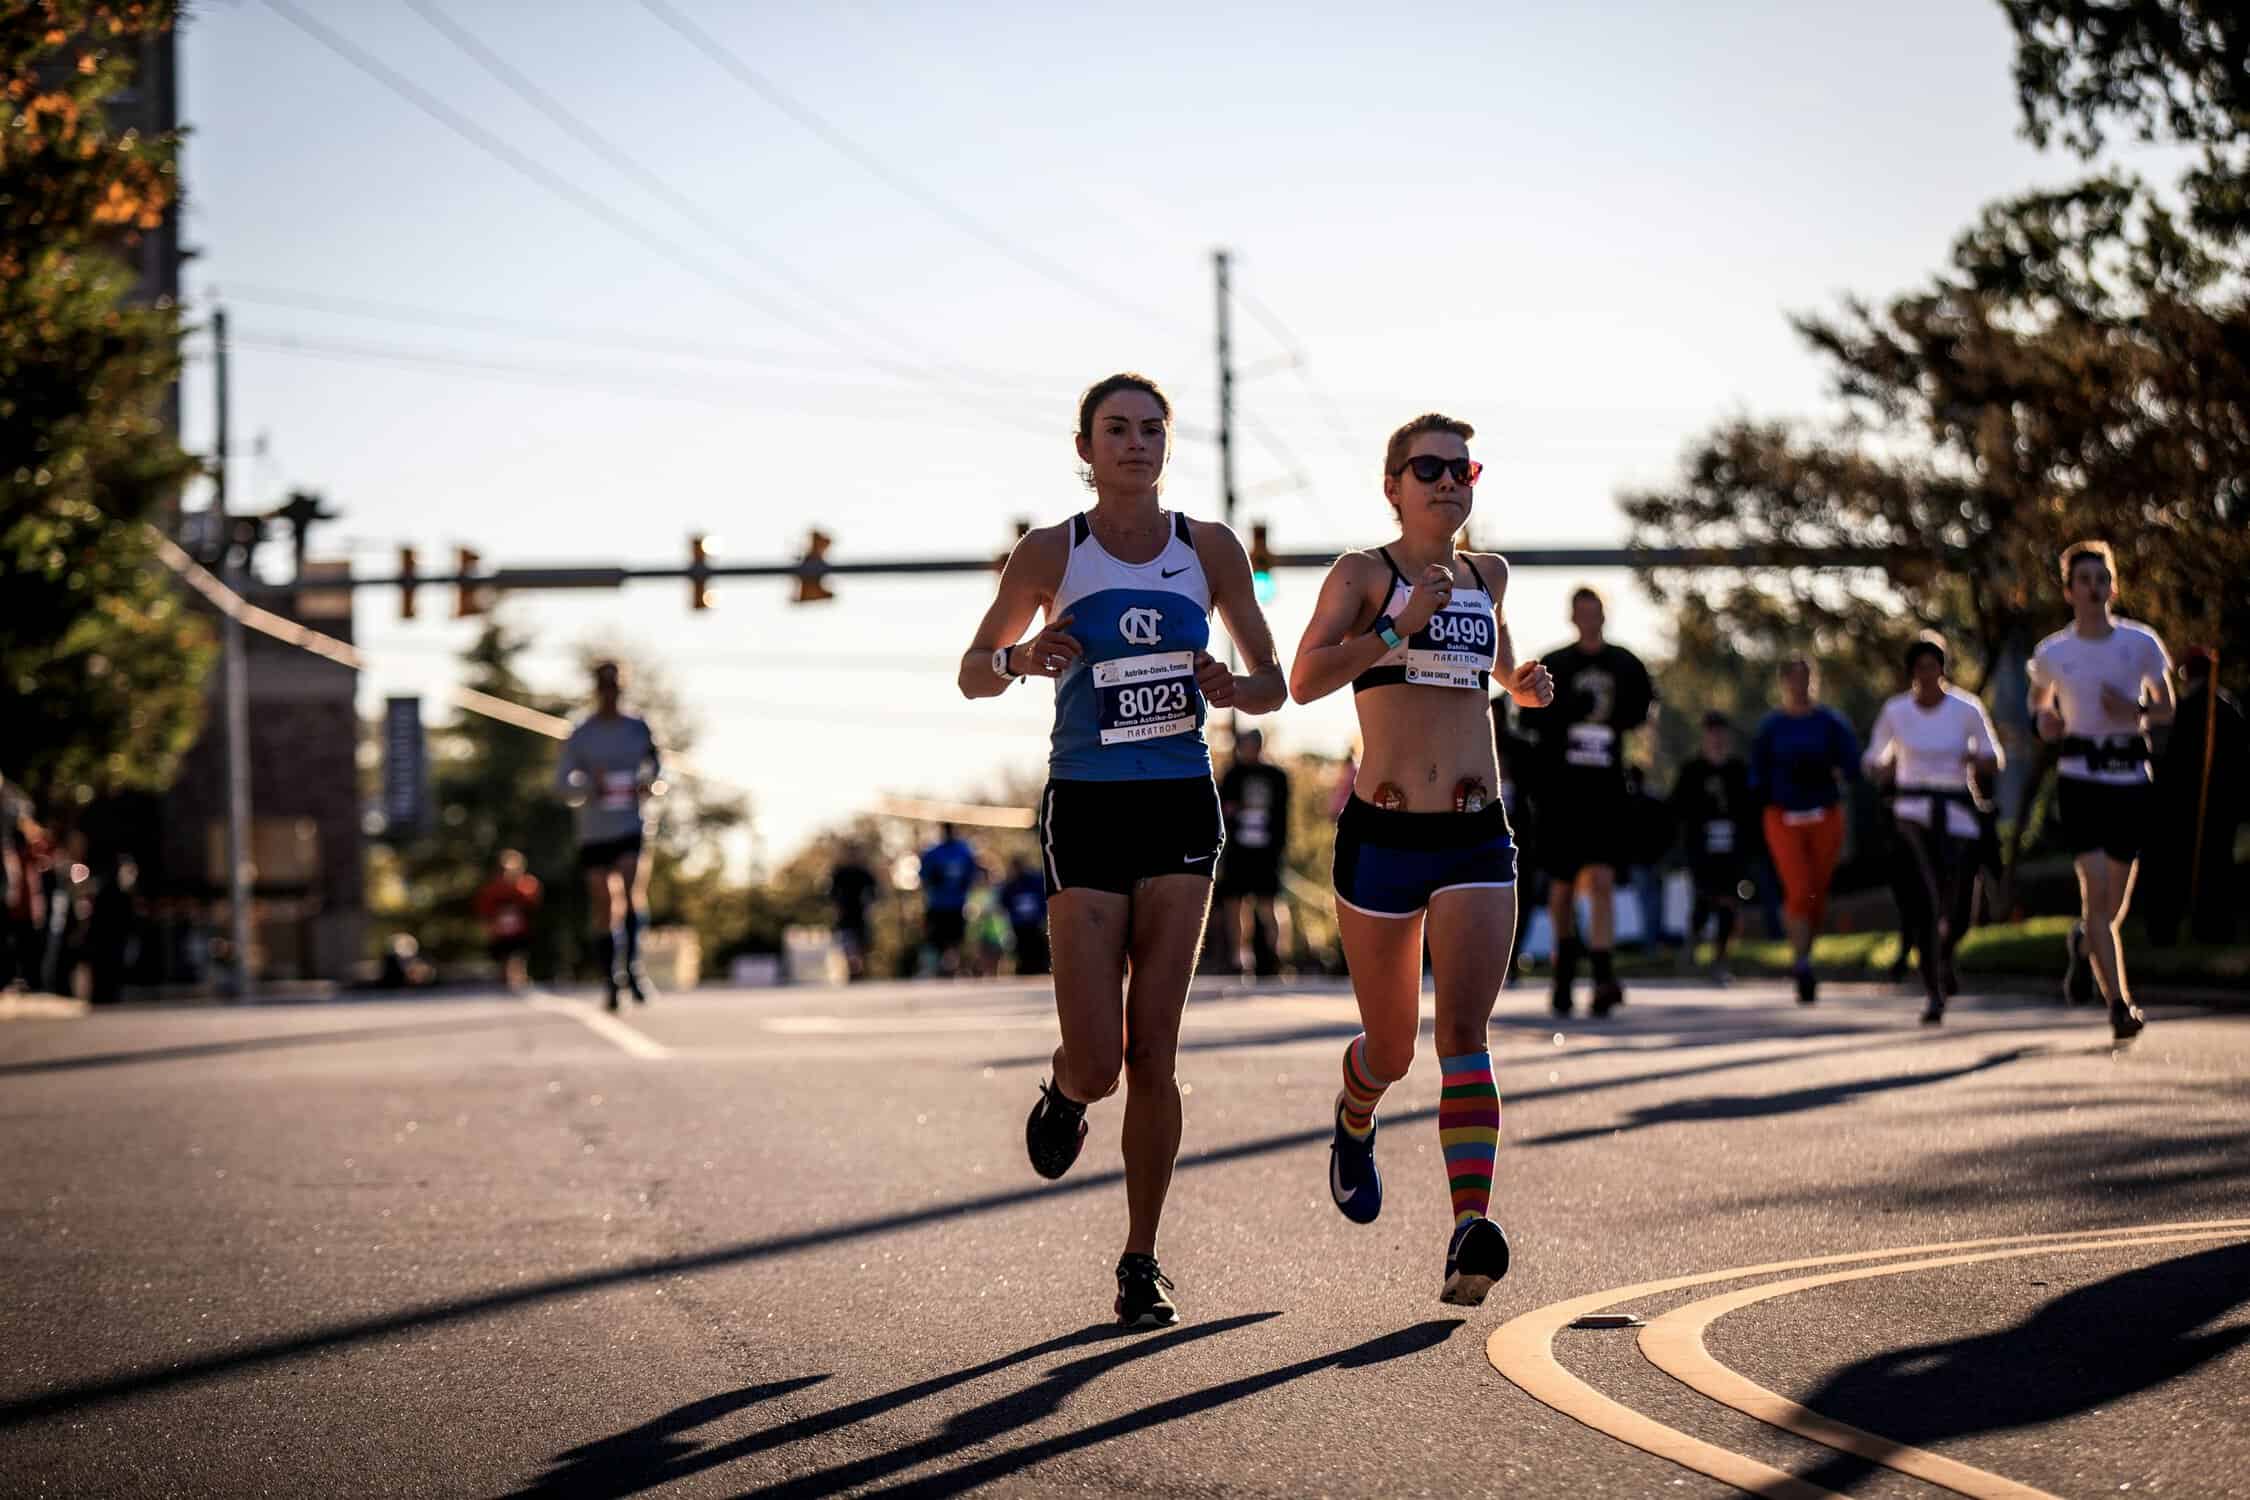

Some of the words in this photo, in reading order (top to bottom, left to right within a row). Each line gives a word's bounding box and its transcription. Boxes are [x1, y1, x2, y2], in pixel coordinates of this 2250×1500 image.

[1430, 615, 1488, 646] 8499
[1119, 682, 1187, 718] 8023
[1114, 719, 1139, 727] Emma
[1127, 722, 1178, 738] MARATHON
